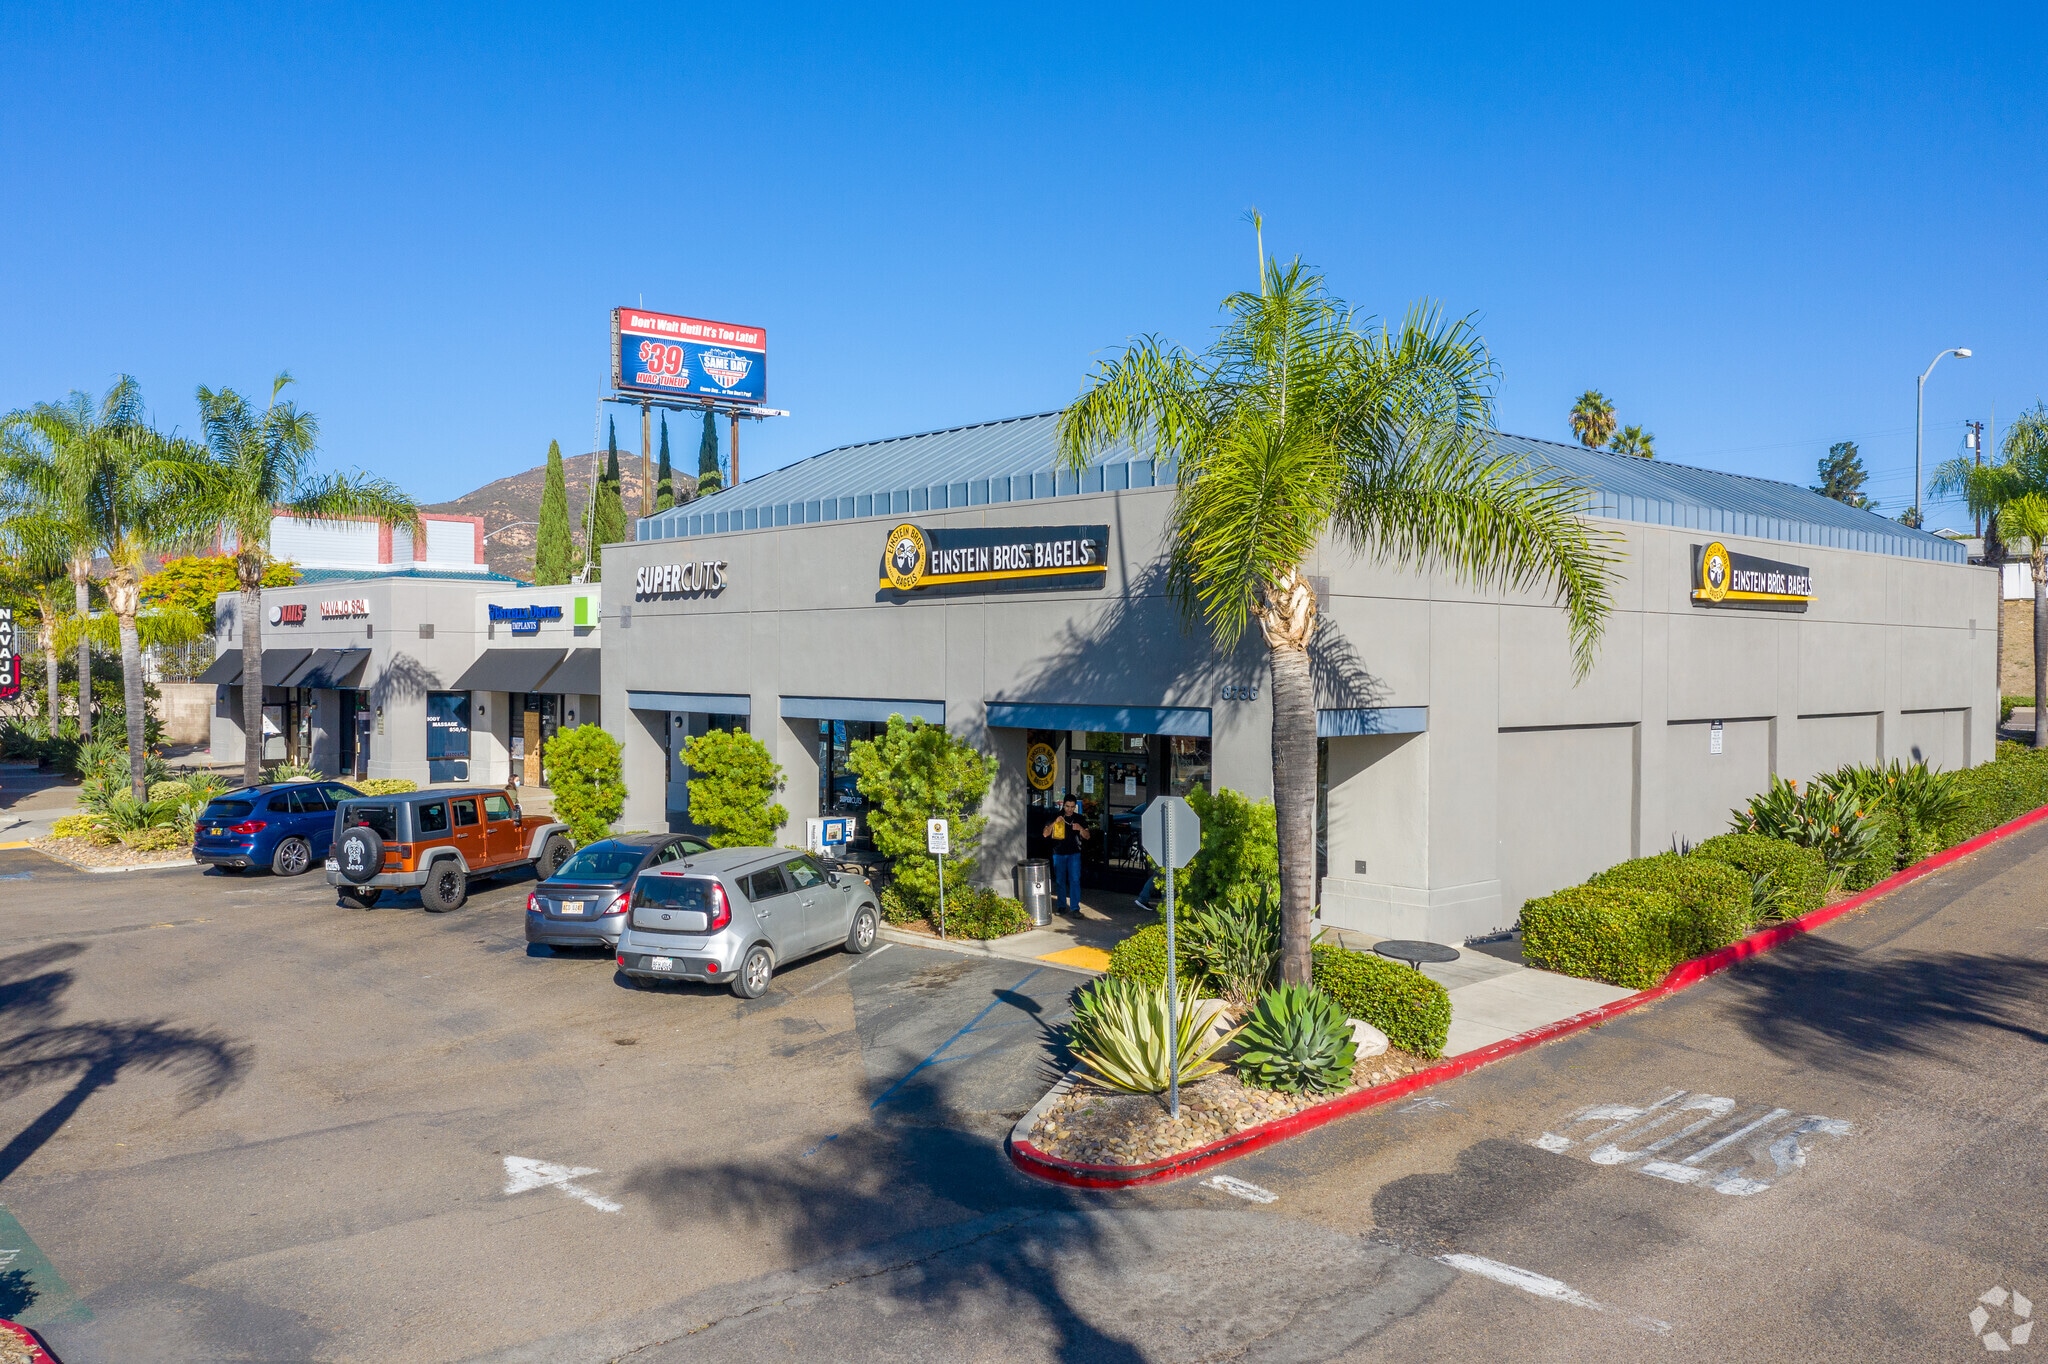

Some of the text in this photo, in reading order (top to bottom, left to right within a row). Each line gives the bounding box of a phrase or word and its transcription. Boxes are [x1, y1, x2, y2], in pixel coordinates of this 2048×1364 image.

[630, 315, 758, 345] Don't Wait Until It's Too Late!
[639, 340, 684, 375] $39
[703, 356, 729, 370] SAME
[730, 359, 747, 372] DAY
[637, 373, 689, 388] HVAC TUNEUP
[887, 527, 924, 554] EINSTEIN BROS
[931, 546, 990, 574] EINSTEIN
[1034, 538, 1089, 567] BAGELS
[636, 560, 722, 594] SUPERCUTS
[895, 573, 918, 588] BAGELS
[1733, 570, 1767, 593] EINSTEIN
[1788, 575, 1813, 596] BAGELS
[281, 604, 304, 622] NAILS
[320, 599, 365, 616] NAVAJO SPA
[512, 622, 537, 630] IMPLANTS
[346, 863, 364, 872] Jeep
